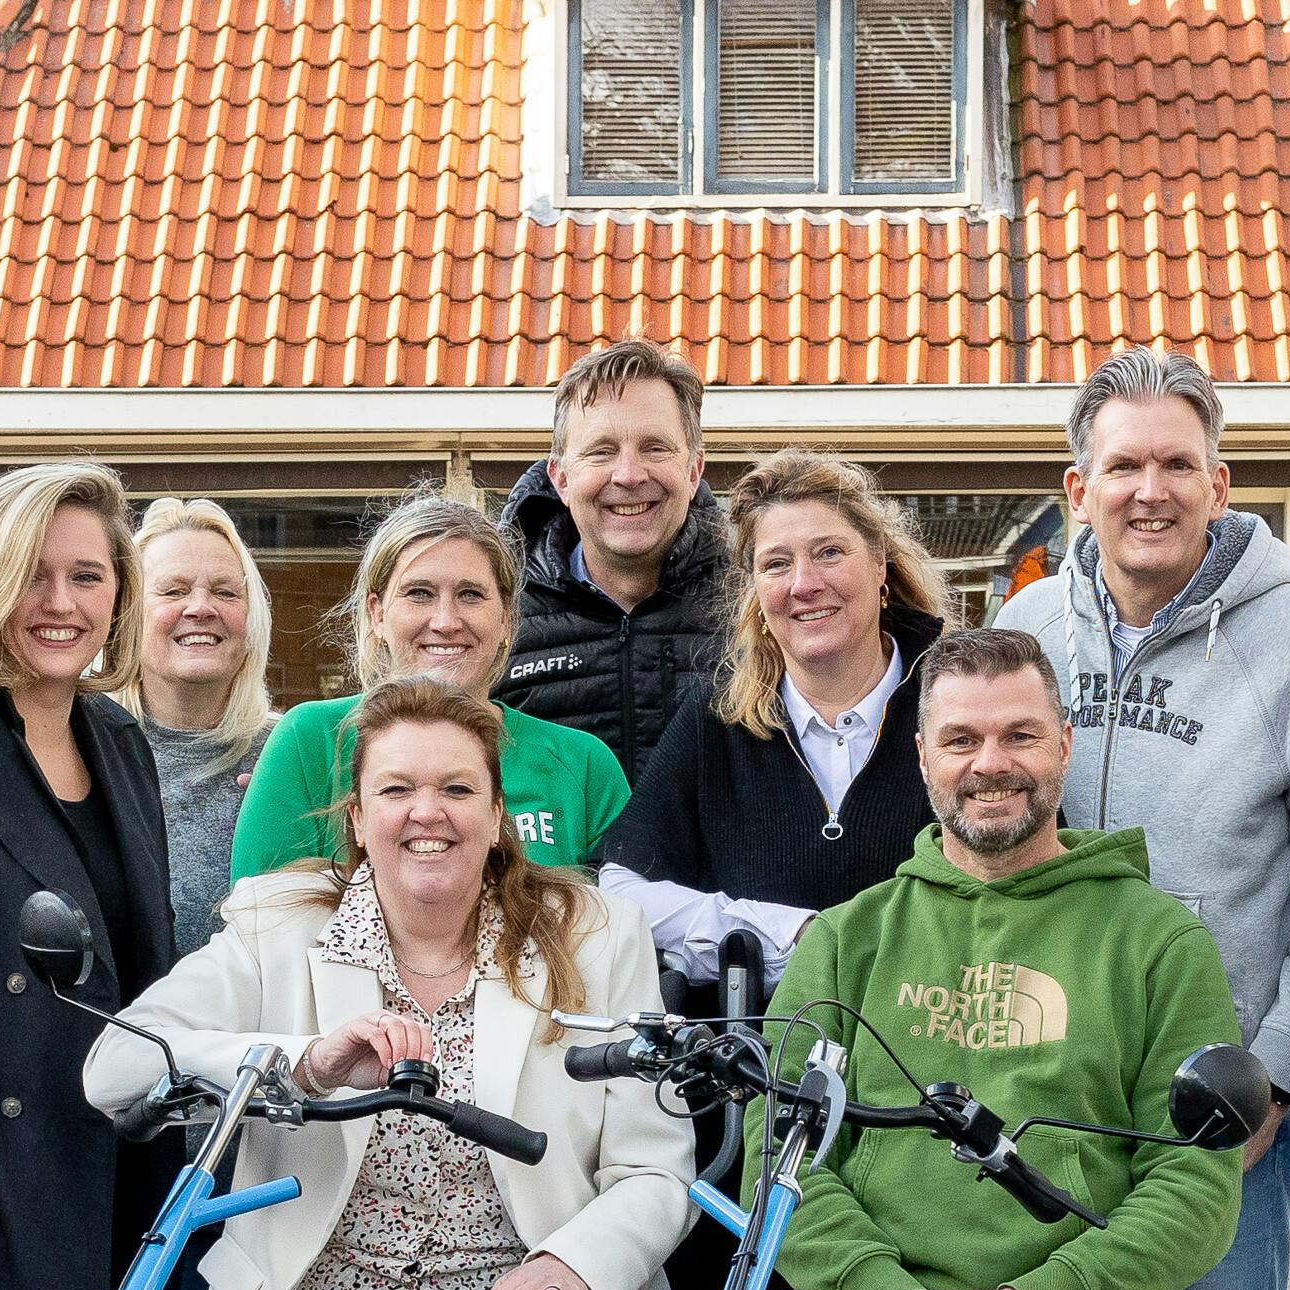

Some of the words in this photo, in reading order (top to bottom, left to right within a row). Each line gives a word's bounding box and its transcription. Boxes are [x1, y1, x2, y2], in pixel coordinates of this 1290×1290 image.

[510, 656, 567, 679] CRAFT
[960, 962, 1015, 992] THE
[897, 982, 1010, 1020] NORTH
[926, 1011, 1008, 1050] FACE
